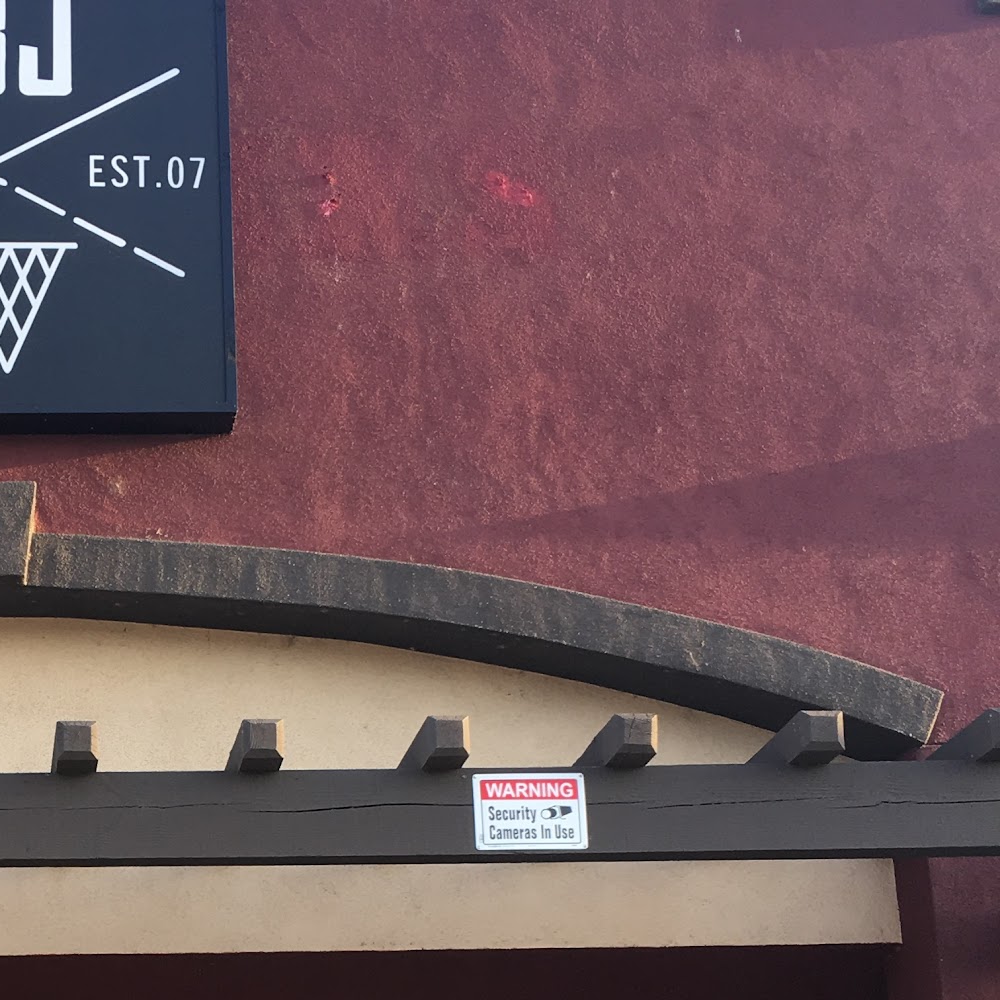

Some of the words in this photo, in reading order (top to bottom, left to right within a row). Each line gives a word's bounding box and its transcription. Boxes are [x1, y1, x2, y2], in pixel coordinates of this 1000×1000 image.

[89, 155, 206, 189] EST.07
[485, 782, 574, 798] WARNING
[488, 806, 537, 823] Security
[489, 825, 537, 840] Cameras
[541, 825, 551, 839] In
[555, 824, 574, 839] Use
